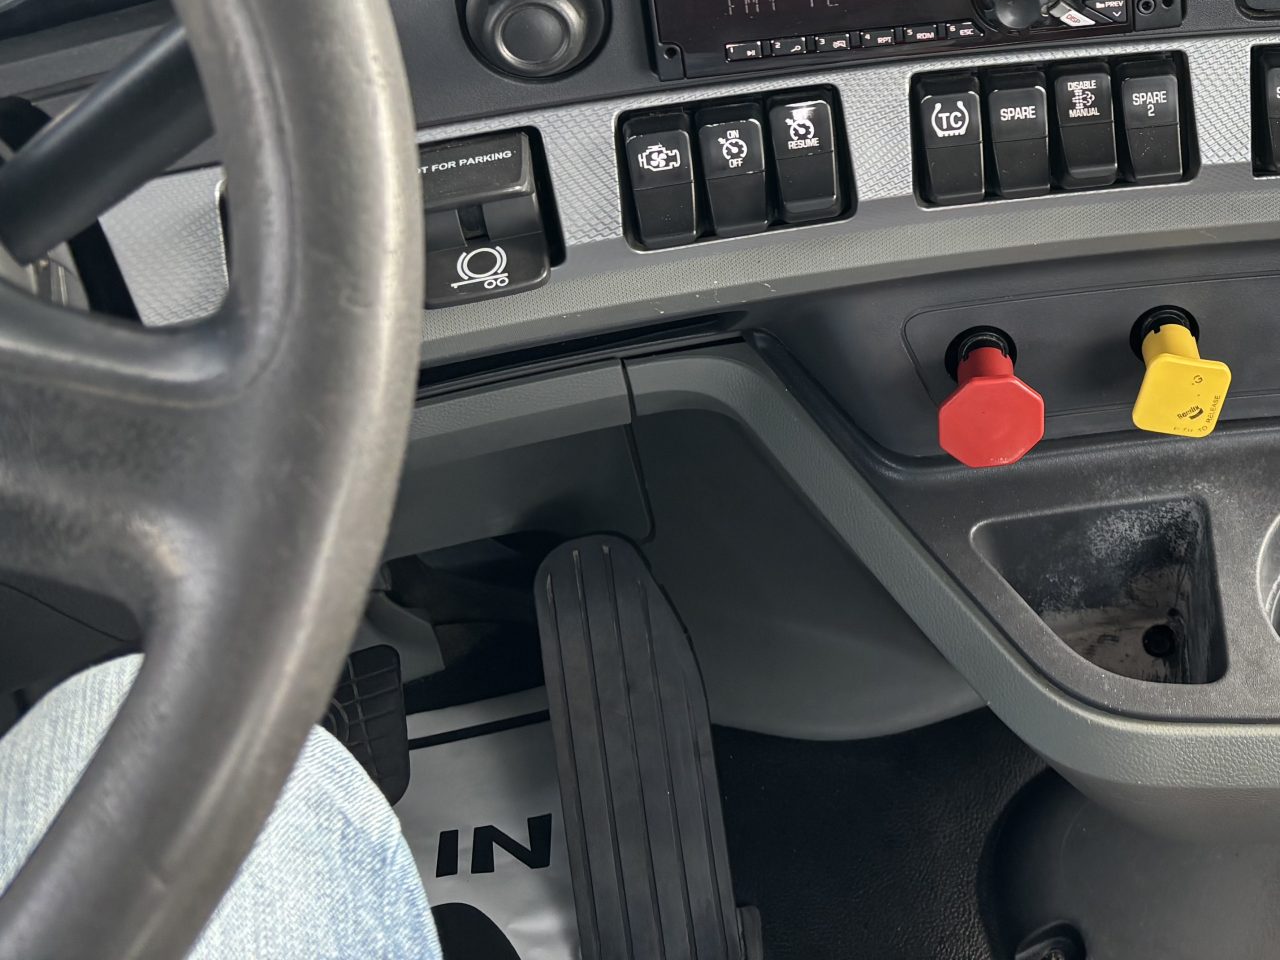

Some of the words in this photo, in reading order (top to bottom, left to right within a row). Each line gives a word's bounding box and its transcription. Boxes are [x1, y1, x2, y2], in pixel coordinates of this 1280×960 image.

[1105, 0, 1124, 8] PREV
[916, 31, 935, 39] RDM
[959, 28, 975, 36] ESC
[1067, 80, 1097, 91] DISABLE
[1132, 90, 1167, 105] SPARE
[1000, 105, 1036, 121] SPARE
[1068, 107, 1100, 118] MANUAL
[1147, 105, 1155, 117] 2
[938, 111, 963, 129] TC
[726, 129, 740, 140] ON
[787, 137, 820, 150] RESUME
[432, 161, 456, 172] FOR
[459, 150, 512, 166] PARKING
[728, 158, 744, 169] OFF
